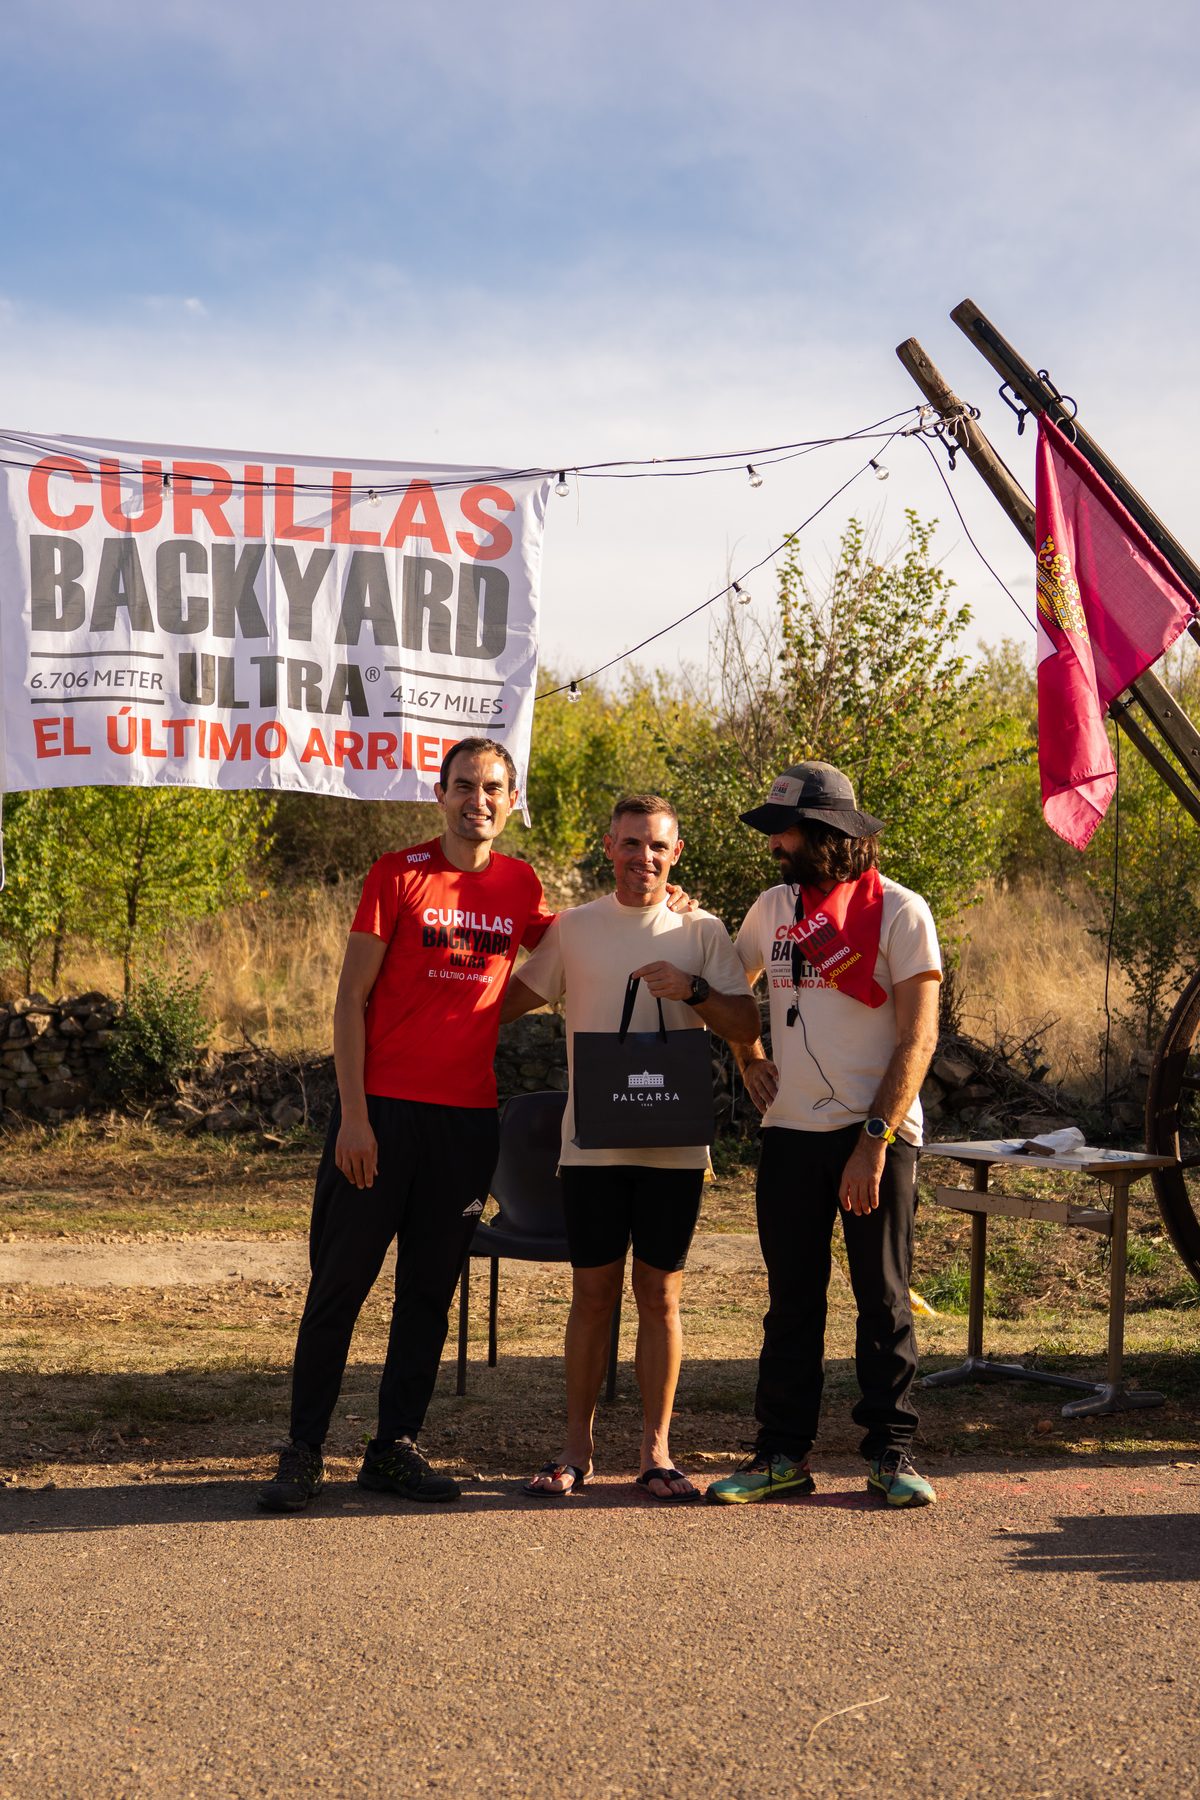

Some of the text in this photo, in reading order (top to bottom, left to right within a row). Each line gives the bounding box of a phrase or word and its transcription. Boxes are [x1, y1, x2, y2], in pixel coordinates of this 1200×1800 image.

[28, 455, 516, 561] CURILLAS
[29, 534, 511, 661] BACKYARD
[30, 669, 164, 690] 6.706 METER
[390, 685, 504, 715] 4.167 MILES
[33, 706, 461, 773] EL ÚLTIMO ARRIE
[423, 907, 514, 935] CURILLAS
[423, 926, 511, 957] BACKYARD
[450, 953, 485, 968] ULTRA
[821, 946, 850, 970] ARRIERO
[829, 952, 861, 978] SOLIDARIA
[428, 969, 438, 978] EL
[613, 1093, 680, 1101] PALCARSA
